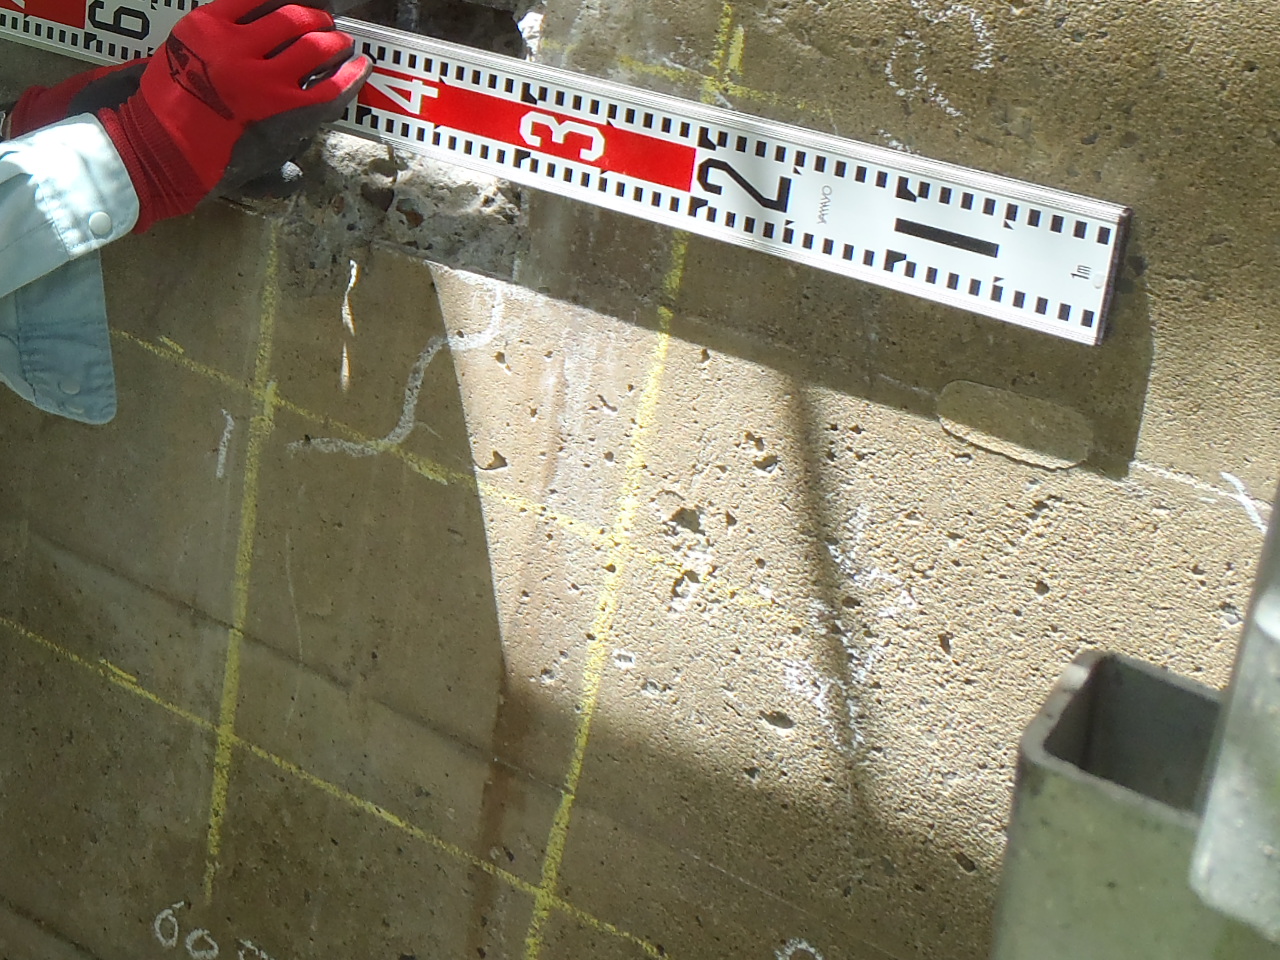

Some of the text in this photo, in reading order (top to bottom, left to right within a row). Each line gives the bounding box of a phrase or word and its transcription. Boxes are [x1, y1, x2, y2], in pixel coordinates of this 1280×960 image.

[369, 73, 438, 115] 4
[519, 109, 606, 164] 3
[698, 157, 791, 213] 2
[895, 217, 999, 258] 1
